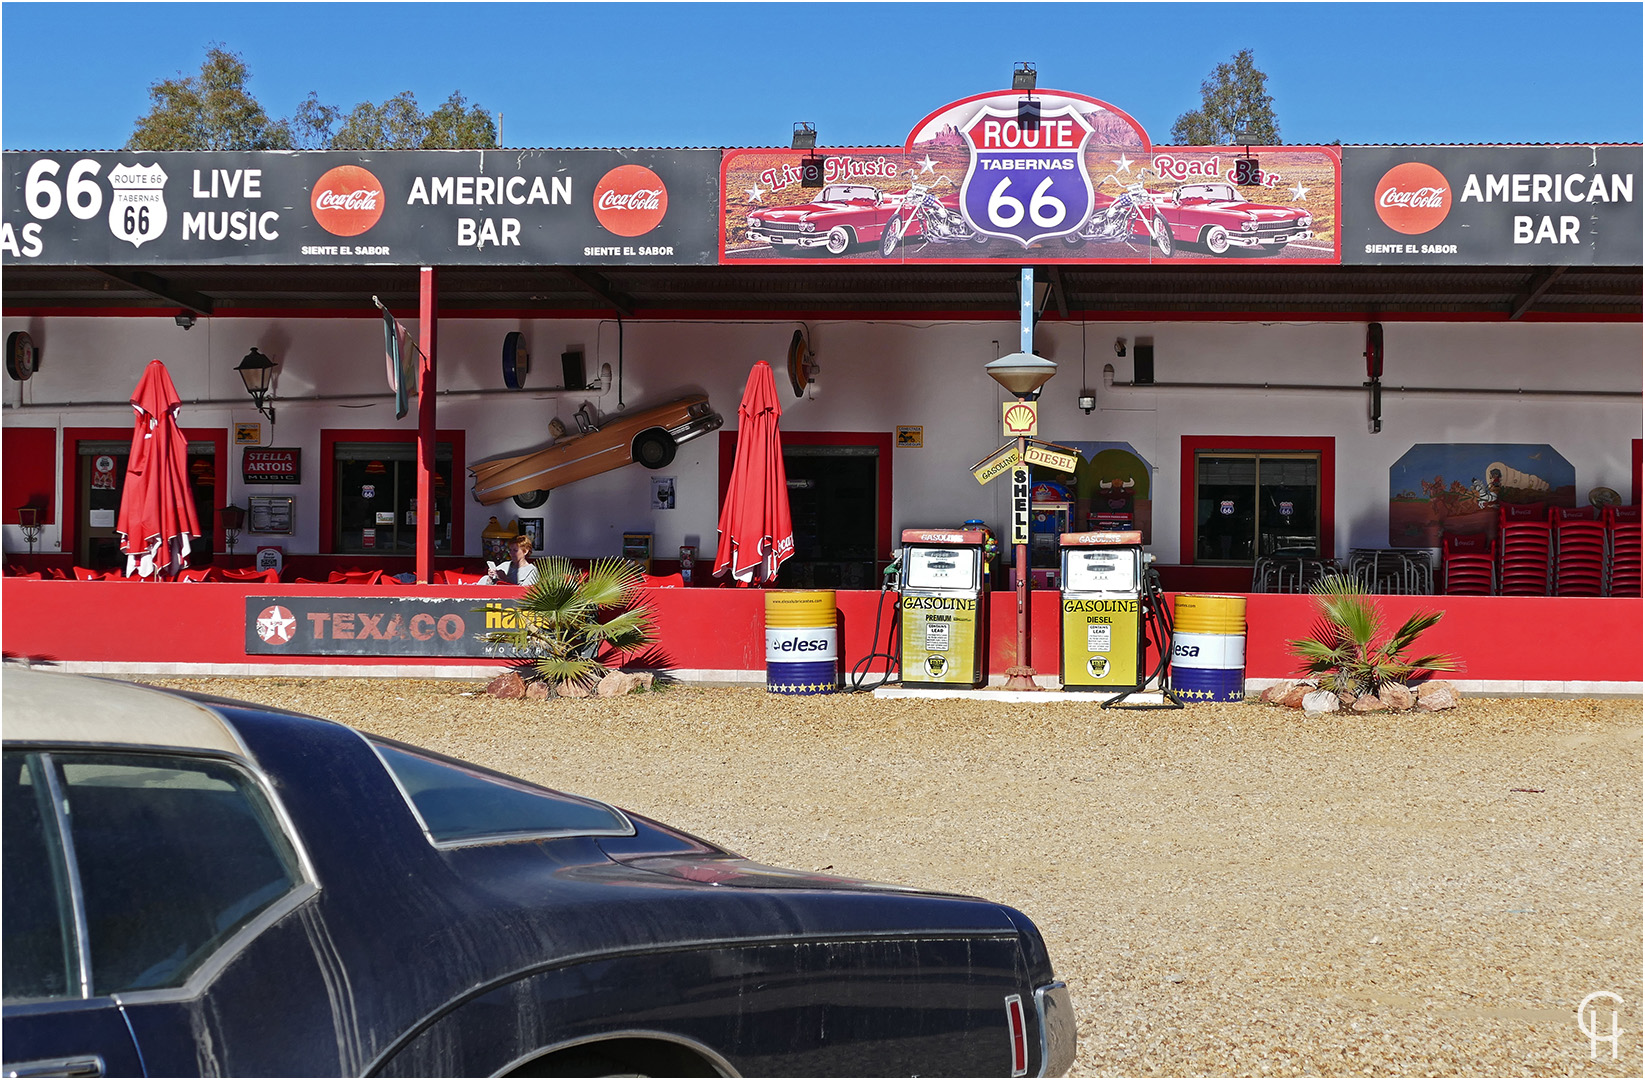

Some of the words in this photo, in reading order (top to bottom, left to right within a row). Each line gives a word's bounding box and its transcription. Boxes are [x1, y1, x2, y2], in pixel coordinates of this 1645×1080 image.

[984, 120, 1073, 147] ROUTE
[761, 164, 819, 192] Live
[824, 156, 898, 181] Music
[981, 158, 1074, 170] TABERNAS
[1153, 155, 1220, 182] Road
[1226, 159, 1281, 188] Bar
[25, 158, 103, 220] 66
[114, 174, 147, 185] ROUTE
[150, 174, 163, 185] 66
[192, 169, 262, 199] LIVE
[406, 176, 572, 205] AMERICAN
[1460, 173, 1633, 203] AMERICAN
[118, 193, 160, 203] TABERNAS
[316, 189, 381, 211] Coca-Cola
[598, 189, 664, 211] Coca-Cola
[988, 176, 1067, 228] 66
[1379, 187, 1447, 209] Coca-Cola
[124, 206, 150, 235] 66
[182, 211, 279, 241] MUSIC
[1513, 215, 1580, 244] BAR
[457, 217, 521, 247] BAR
[301, 245, 338, 255] SIENTE
[340, 245, 353, 255] EL
[355, 245, 390, 255] SABOR
[583, 246, 621, 256] SIENTE
[623, 246, 636, 256] EL
[638, 246, 674, 256] SABOR
[1365, 244, 1404, 254] SIENTE
[1405, 244, 1420, 254] EL
[1421, 244, 1458, 254] SABOR
[248, 452, 292, 461] STELLA
[248, 462, 293, 471] ARTOIS
[981, 453, 1018, 480] GASOLINE
[1029, 449, 1074, 470] DIESEL
[1014, 470, 1027, 540] SHELL
[903, 597, 976, 610] GASOLINE
[1064, 600, 1138, 612] GASOLINE
[306, 612, 466, 641] TEXACO
[925, 614, 952, 622] PREMIUM
[781, 636, 829, 652] elesa
